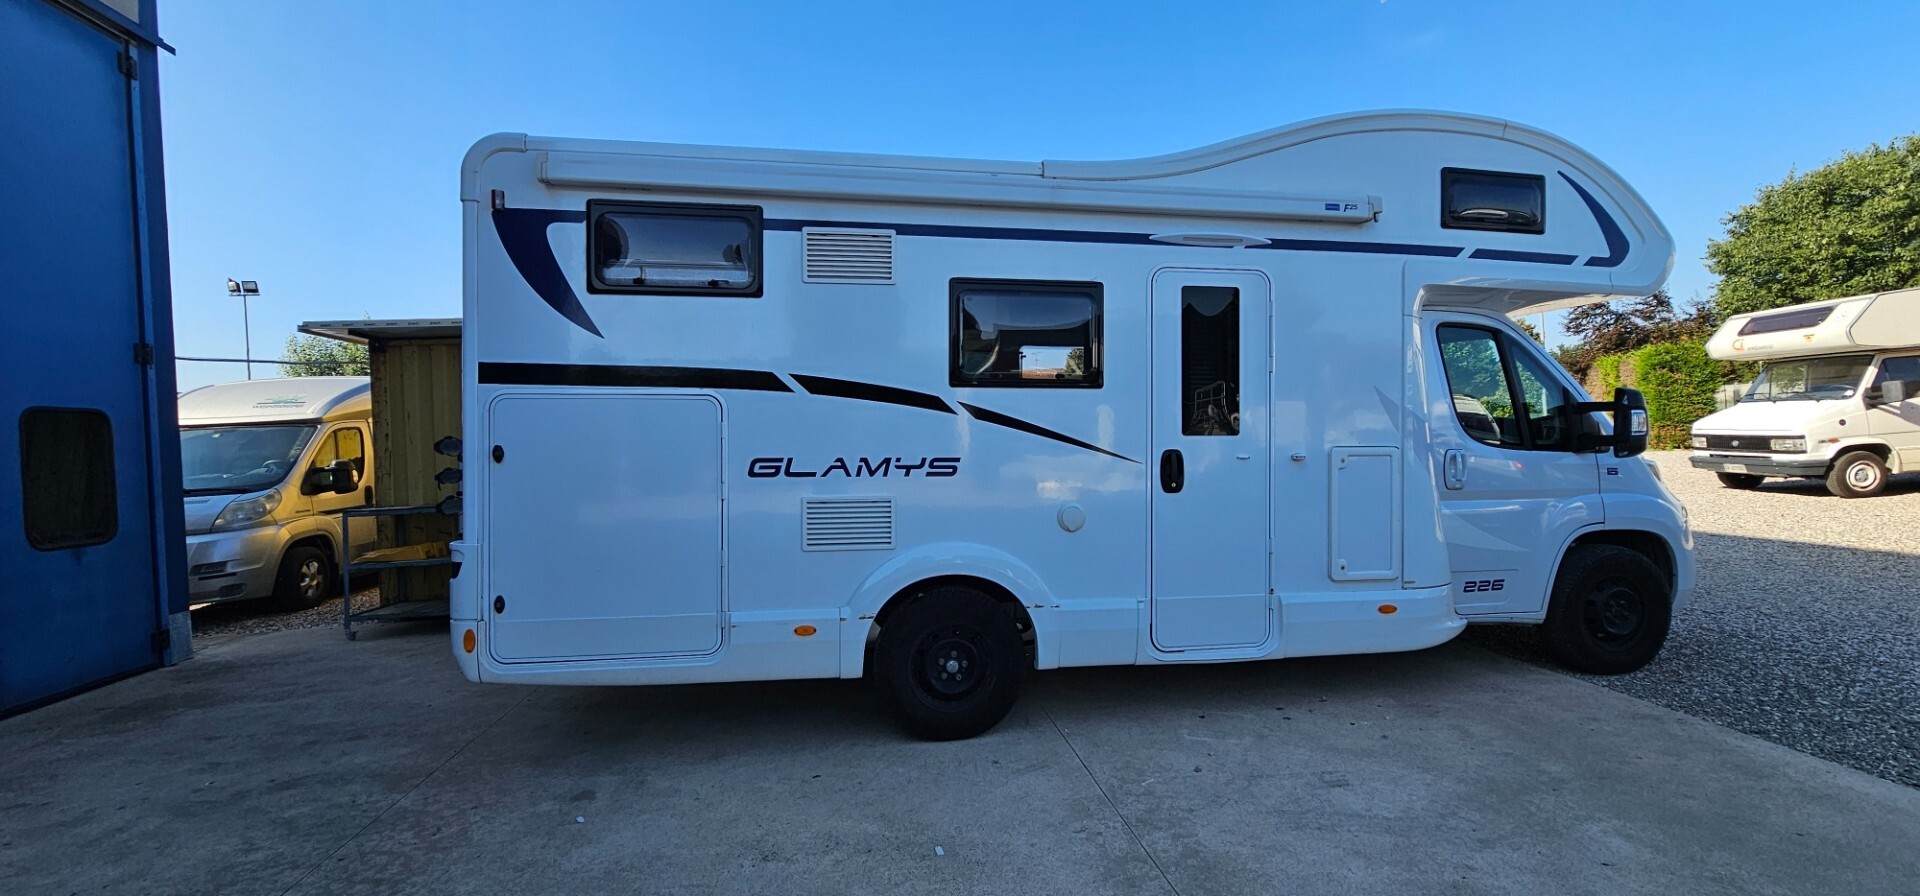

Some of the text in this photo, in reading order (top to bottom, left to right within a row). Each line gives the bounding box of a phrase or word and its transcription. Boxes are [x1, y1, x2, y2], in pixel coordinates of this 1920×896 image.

[1343, 203, 1358, 212] F25
[747, 457, 961, 478] GLAMYS
[1463, 579, 1505, 593] 226
